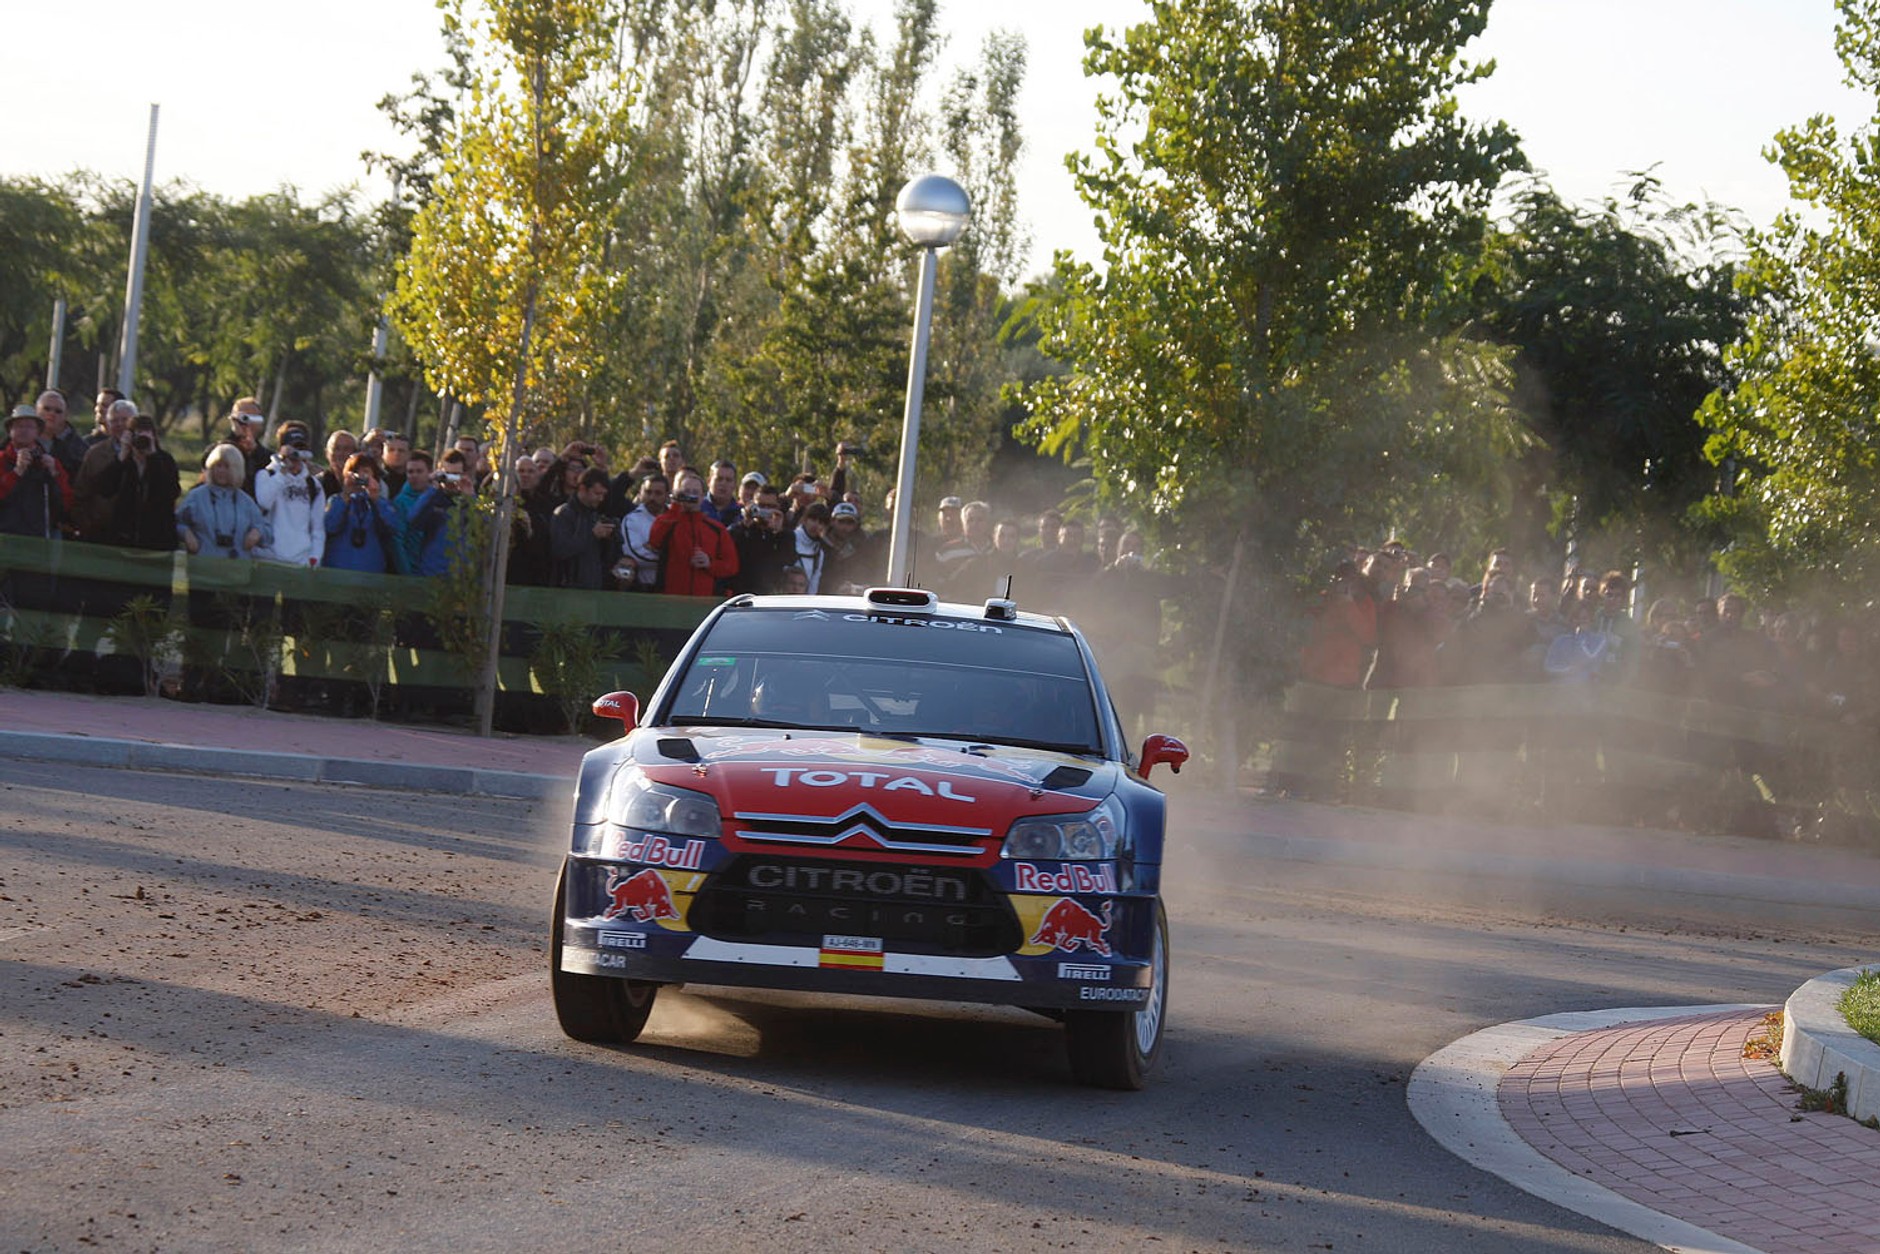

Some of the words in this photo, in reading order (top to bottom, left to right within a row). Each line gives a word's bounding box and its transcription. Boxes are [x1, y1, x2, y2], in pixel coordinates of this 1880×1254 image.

[760, 768, 976, 803] TOTAL
[645, 836, 706, 870] Bull
[1014, 862, 1076, 892] Red
[597, 929, 647, 949] PIRELLI
[1058, 962, 1112, 980] PIRELLI
